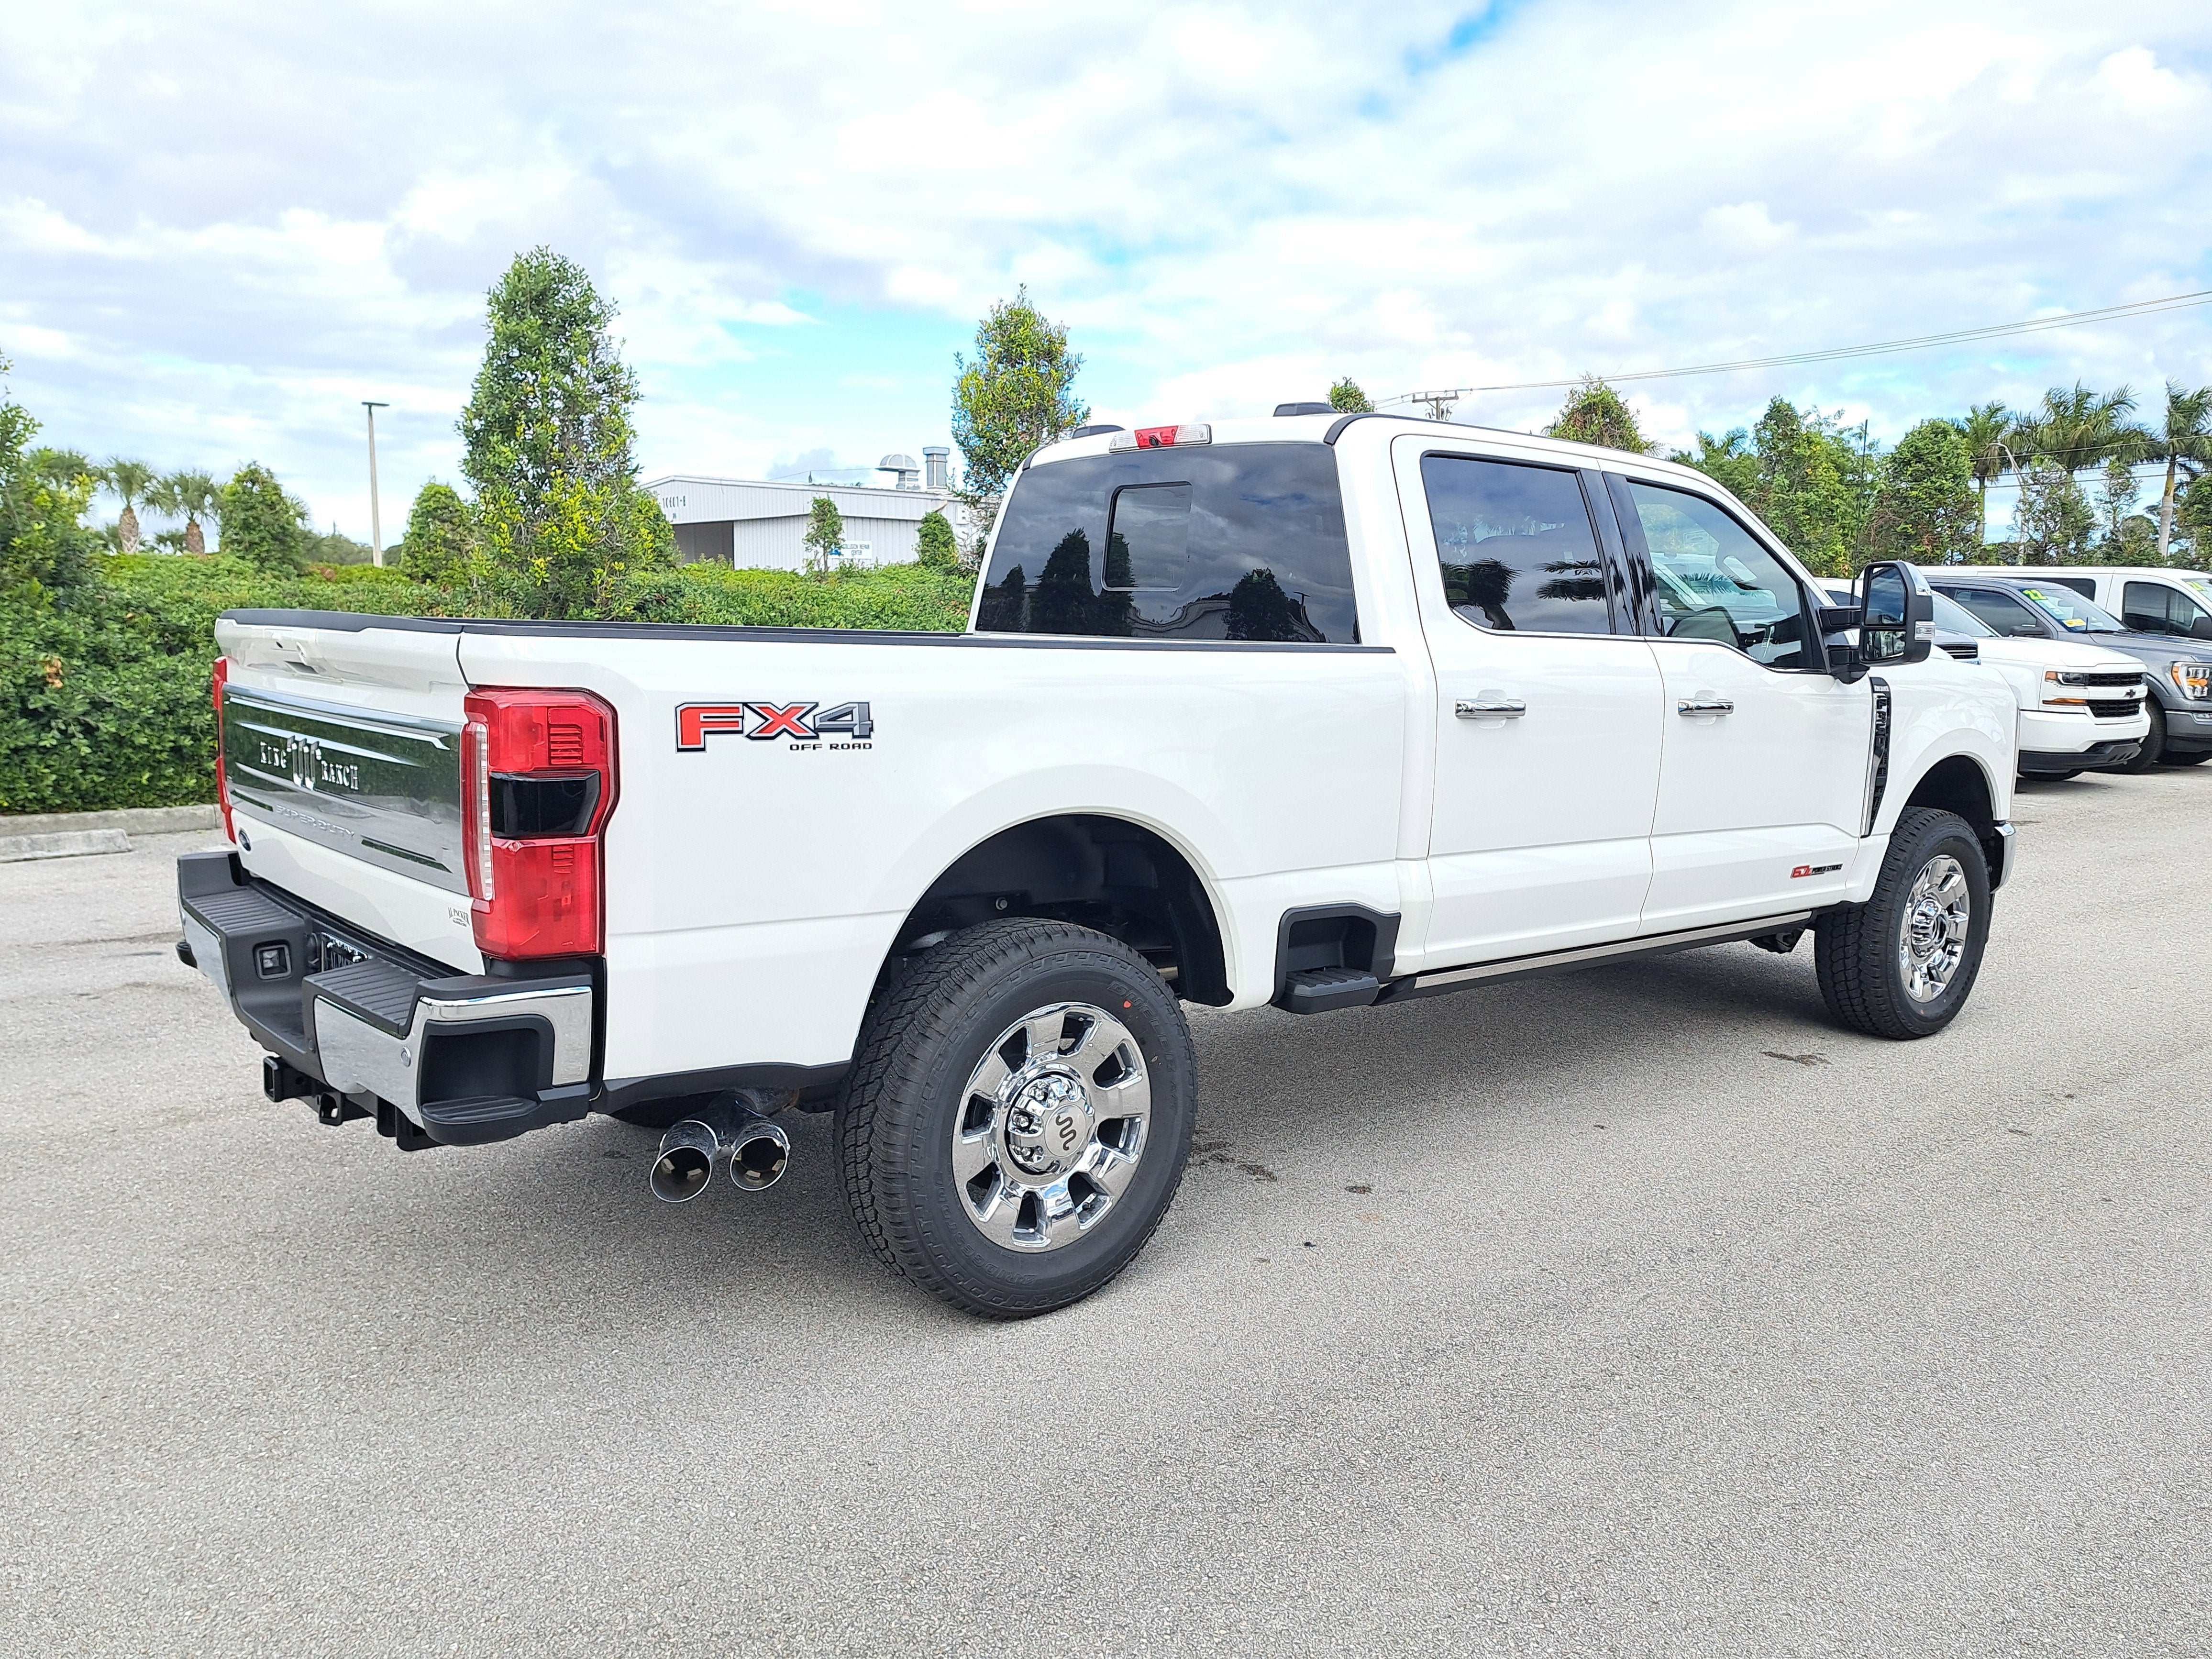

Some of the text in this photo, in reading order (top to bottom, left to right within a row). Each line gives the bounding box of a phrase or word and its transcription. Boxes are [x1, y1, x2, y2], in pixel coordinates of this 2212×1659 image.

[2023, 589, 2048, 600] 22
[675, 701, 874, 753] FX4
[830, 742, 872, 751] ROAD
[260, 741, 359, 790] KING RANCH
[276, 804, 355, 838] SUPER DUTY
